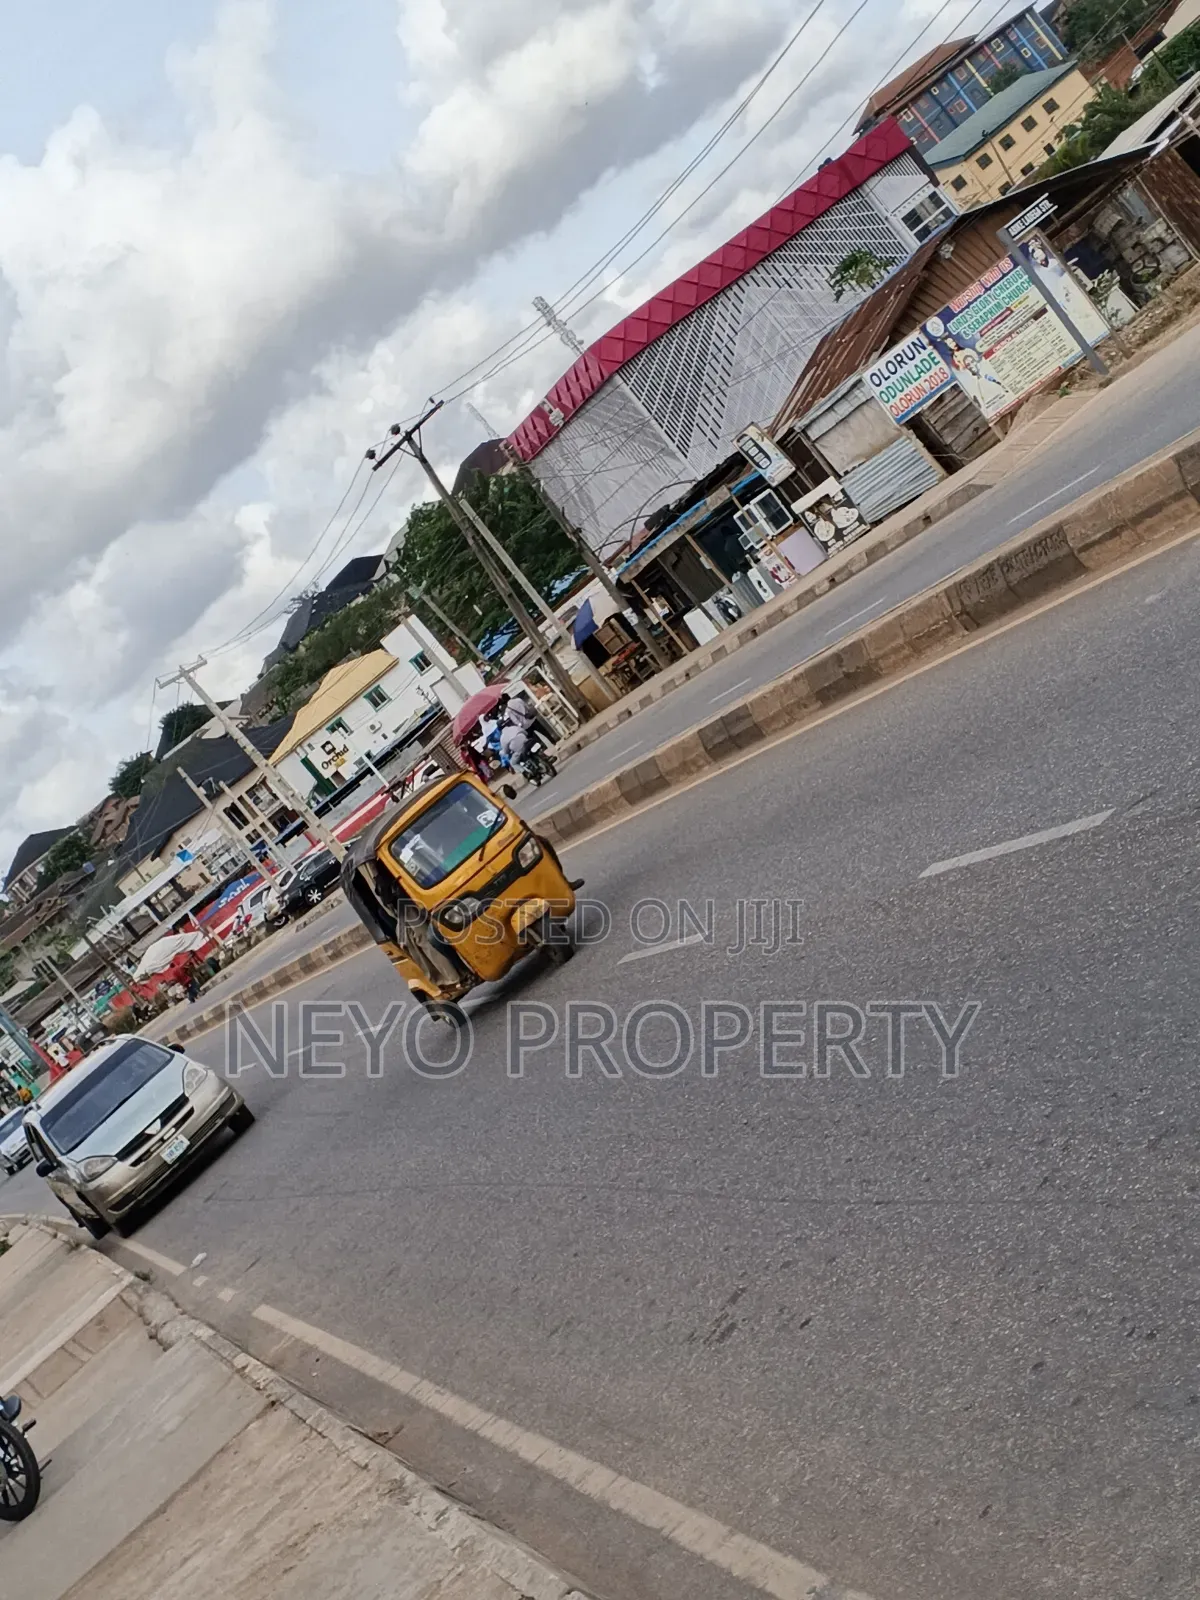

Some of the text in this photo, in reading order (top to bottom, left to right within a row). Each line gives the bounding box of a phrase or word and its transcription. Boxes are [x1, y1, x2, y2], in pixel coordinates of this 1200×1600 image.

[947, 308, 974, 332] LORD'S
[969, 291, 995, 314] GLORY
[949, 282, 985, 313] Worship
[981, 267, 1003, 287] with
[967, 300, 1004, 332] SERAPHIM
[1001, 275, 1034, 306] CHURCH
[870, 338, 927, 388] OLORUN
[879, 352, 940, 404] ODUNLADE
[889, 368, 949, 417] OLORUN 2018
